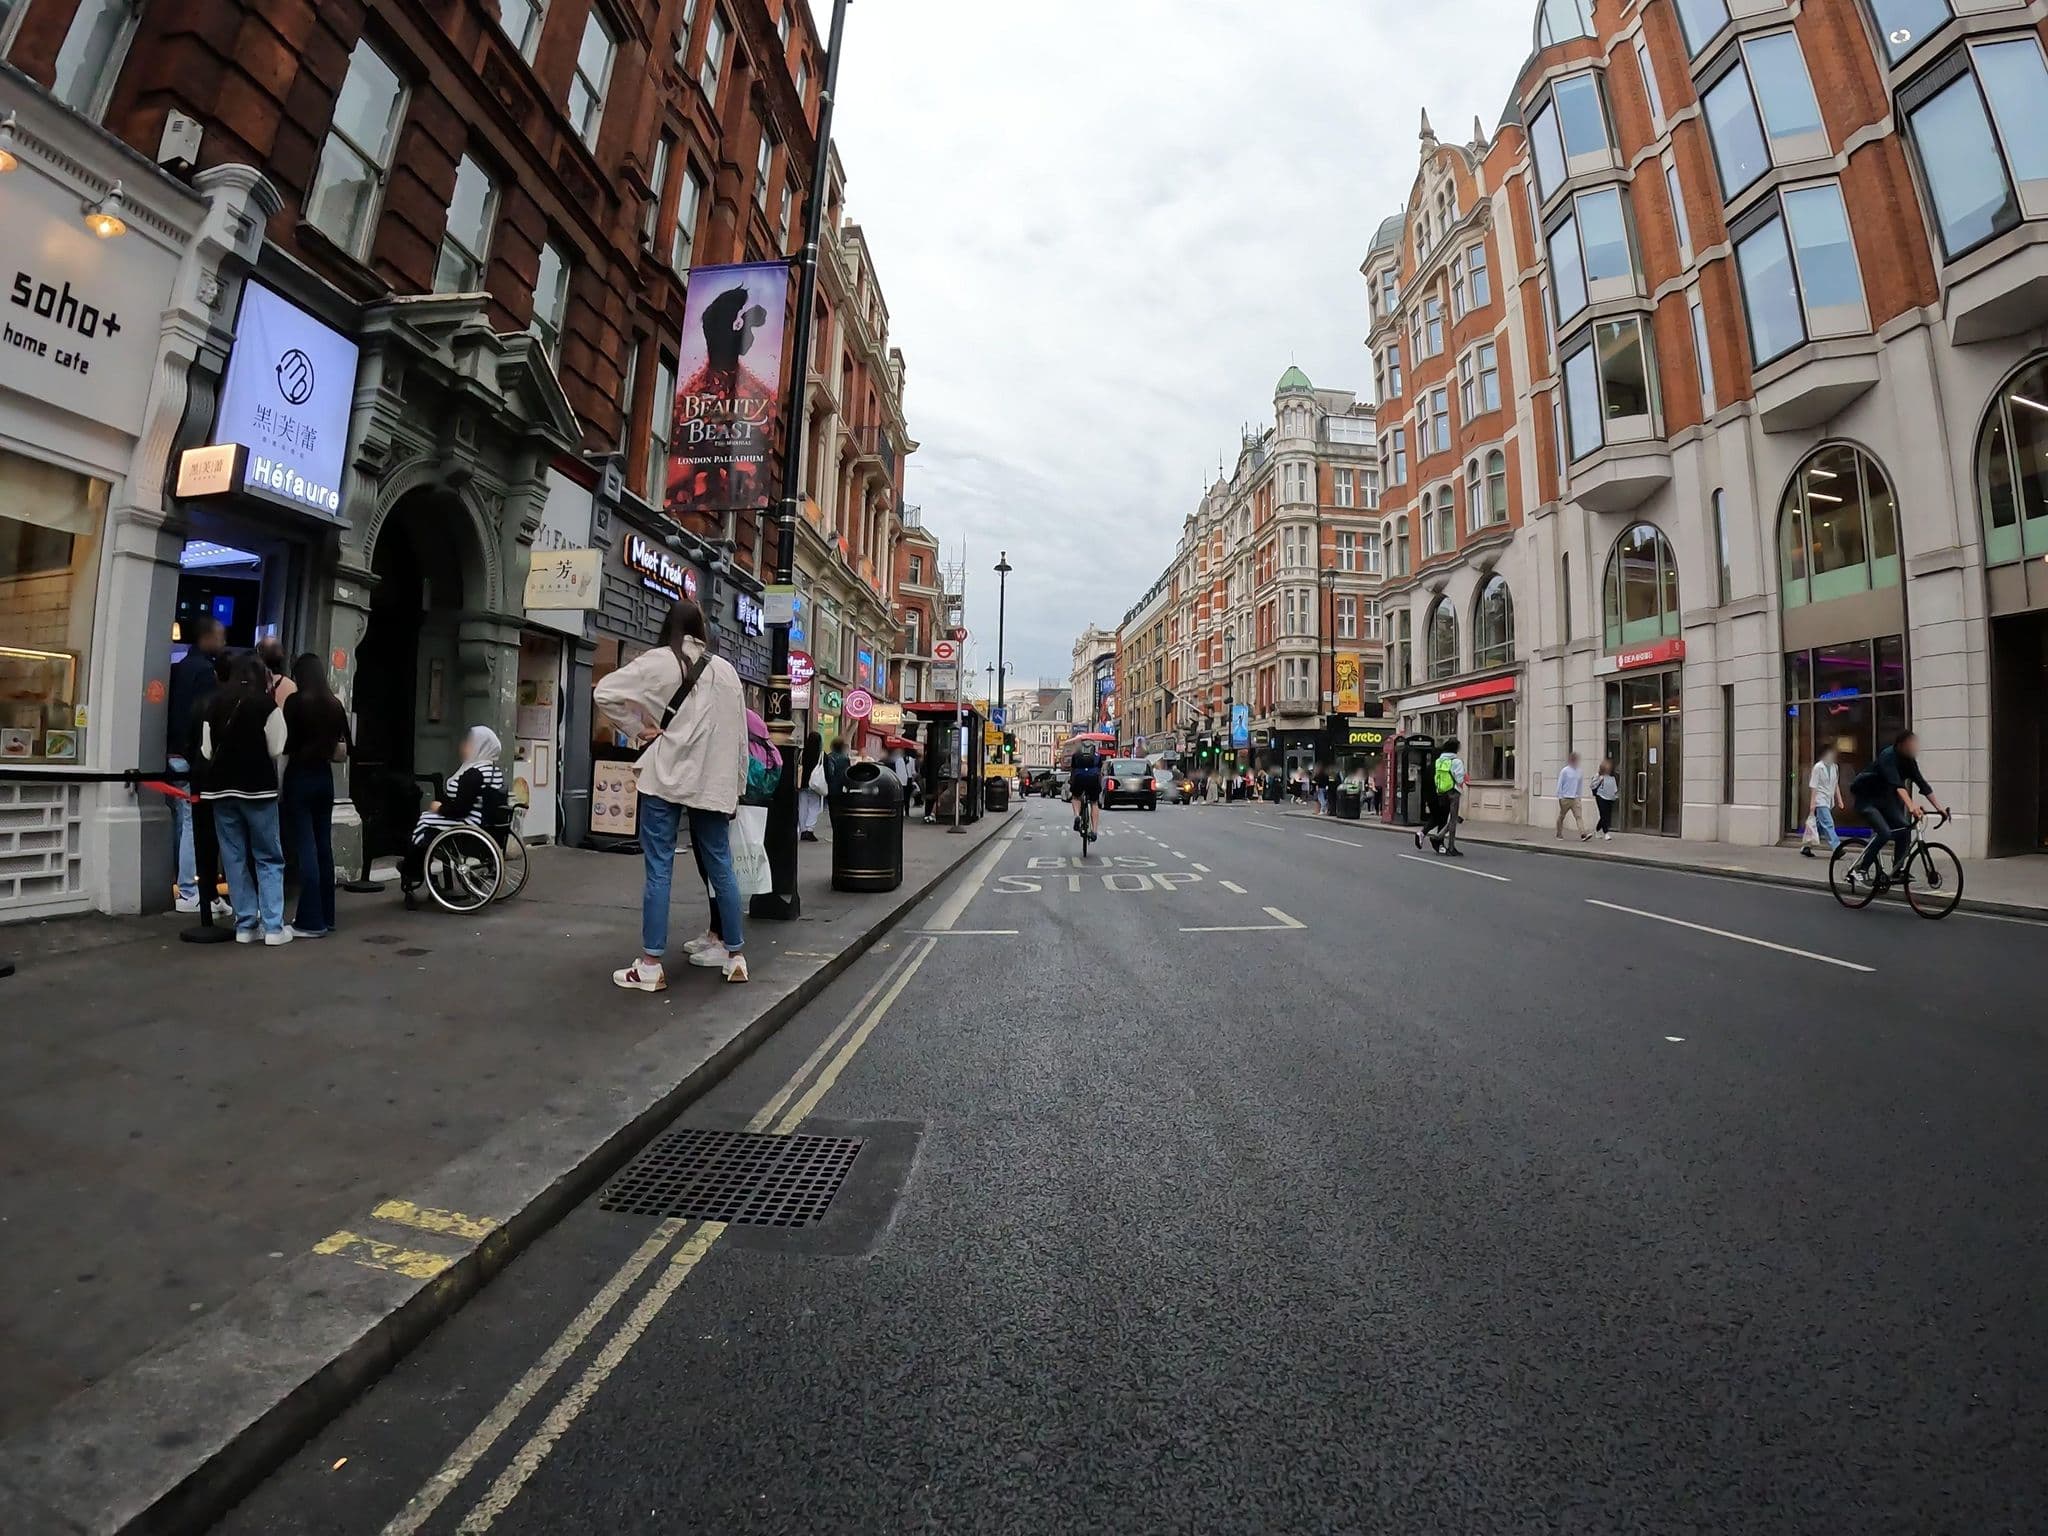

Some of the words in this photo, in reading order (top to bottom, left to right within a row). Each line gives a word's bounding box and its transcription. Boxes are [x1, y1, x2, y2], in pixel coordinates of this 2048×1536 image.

[10, 271, 122, 338] soho+
[3, 322, 48, 357] home
[55, 348, 90, 375] cafe
[685, 395, 770, 420] BEAUTY
[682, 417, 765, 443] BEAST
[677, 456, 713, 465] LONDON
[713, 455, 764, 464] PALLADIUM
[253, 455, 340, 511] Héfaure
[531, 559, 573, 580] 一芳
[632, 535, 660, 572] Meet
[659, 554, 682, 586] Fresh
[791, 666, 814, 676] Fresh
[1349, 732, 1382, 744] preto
[1026, 856, 1159, 870] BUS
[992, 873, 1204, 894] STOP
